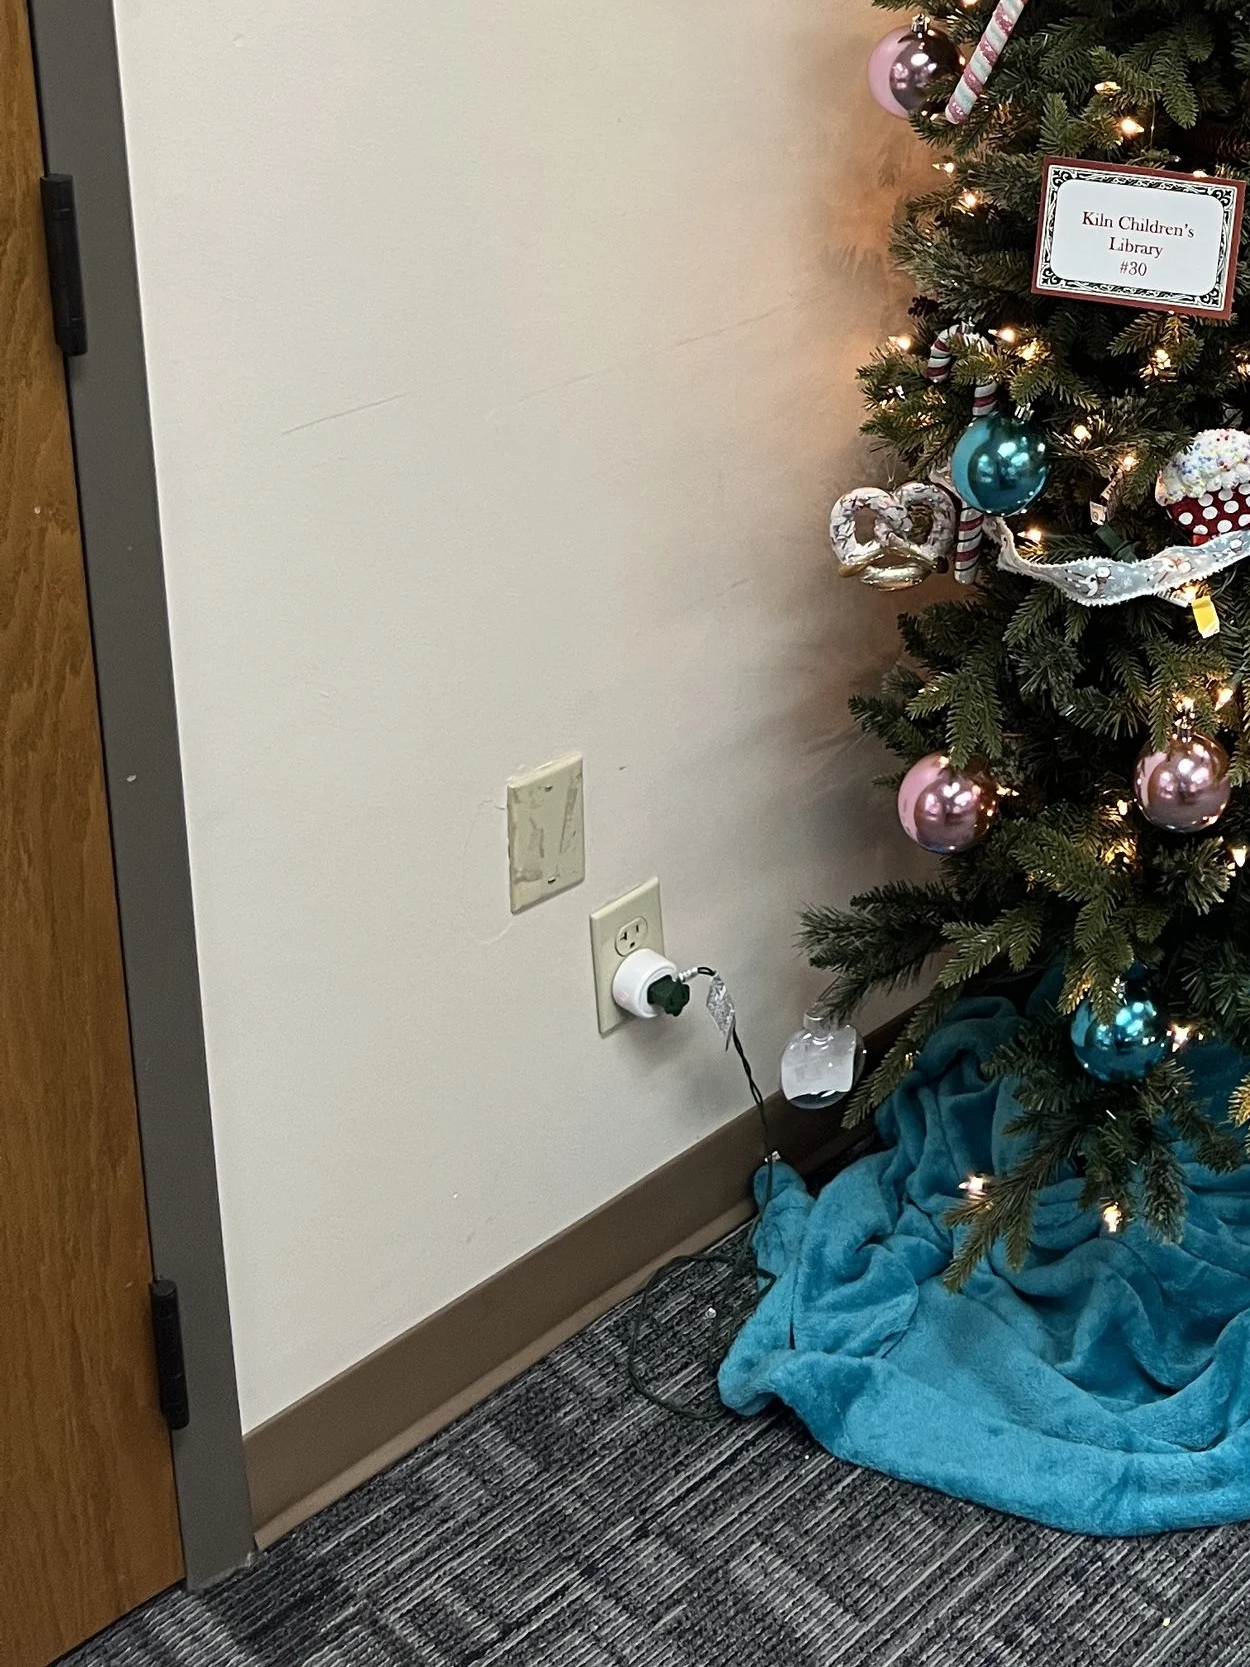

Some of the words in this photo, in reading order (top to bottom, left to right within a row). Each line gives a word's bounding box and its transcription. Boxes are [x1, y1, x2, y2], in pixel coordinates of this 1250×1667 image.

[1081, 211, 1114, 229] Kiln
[1118, 215, 1195, 238] Children's
[1109, 236, 1164, 258] Library
[1119, 261, 1148, 277] #30
